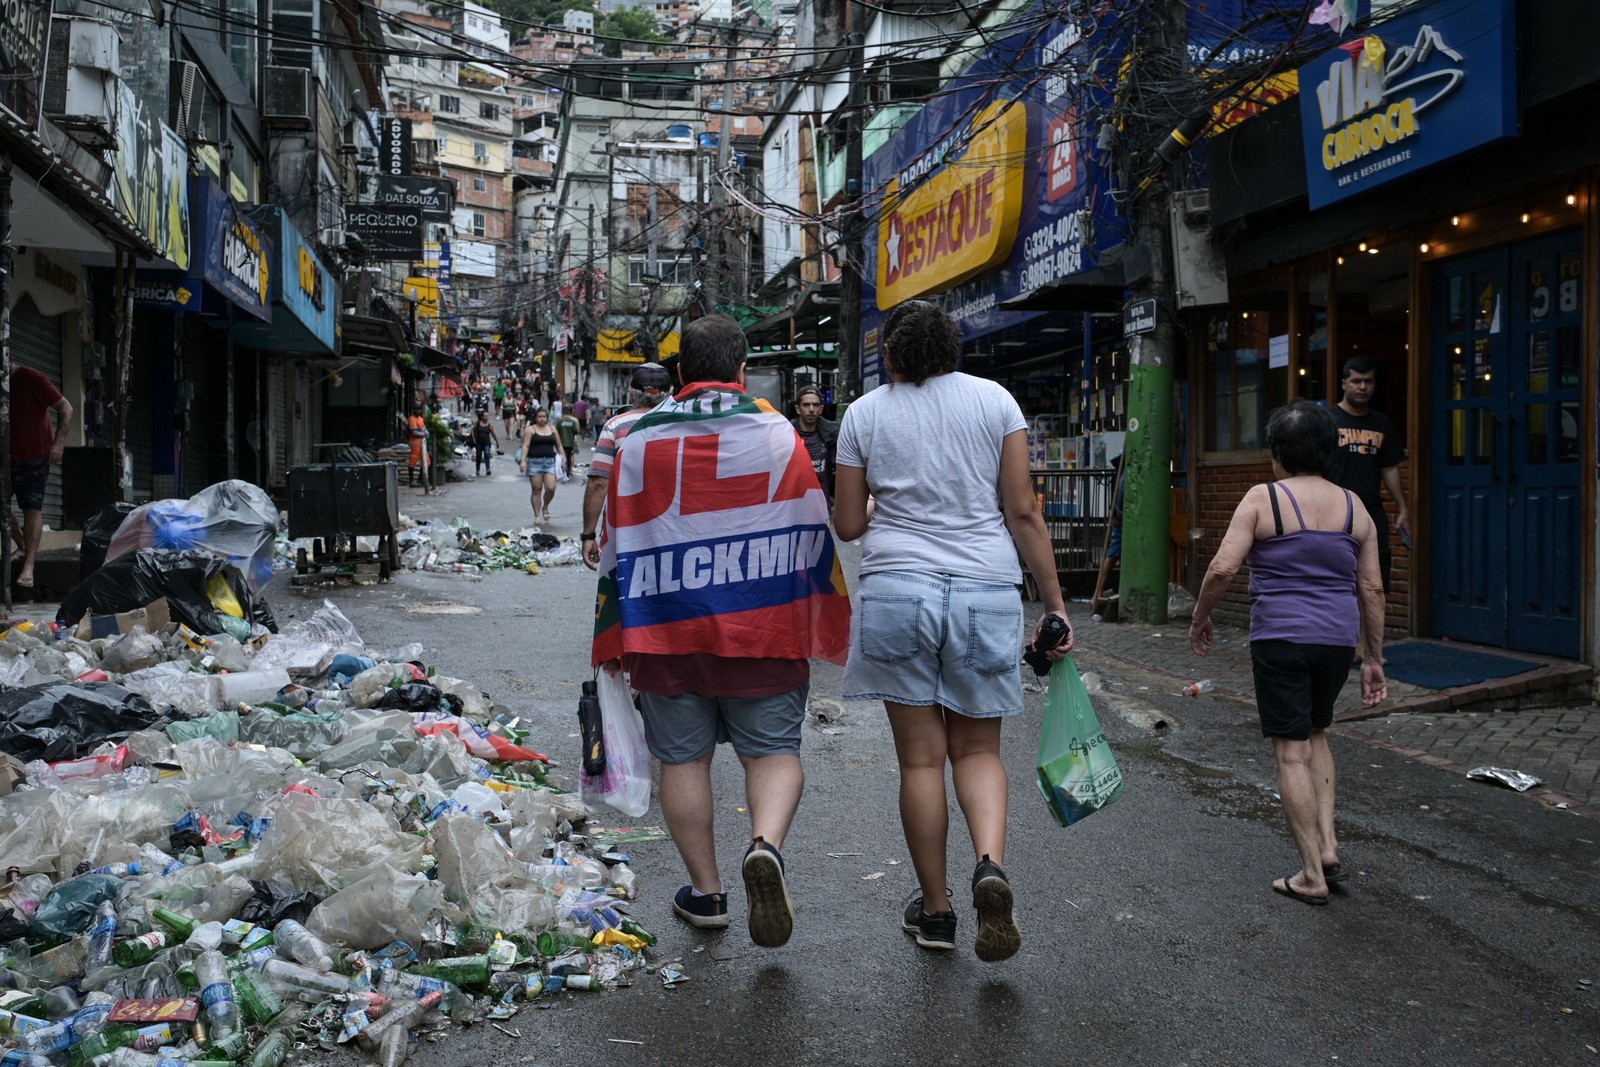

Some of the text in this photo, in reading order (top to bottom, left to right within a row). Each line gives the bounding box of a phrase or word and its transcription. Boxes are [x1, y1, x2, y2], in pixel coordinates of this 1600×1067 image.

[1316, 50, 1386, 130] VIA
[391, 119, 402, 174] ADVOGADO
[1052, 122, 1072, 171] 24
[1322, 97, 1418, 170] CARIOCA
[1338, 150, 1412, 187] BAR E RESTAURANTE
[349, 213, 418, 227] PEQUENO
[385, 192, 440, 206] DAI SOUZA
[884, 166, 997, 287] DESTAQUE
[1028, 242, 1082, 292] 98857-9824
